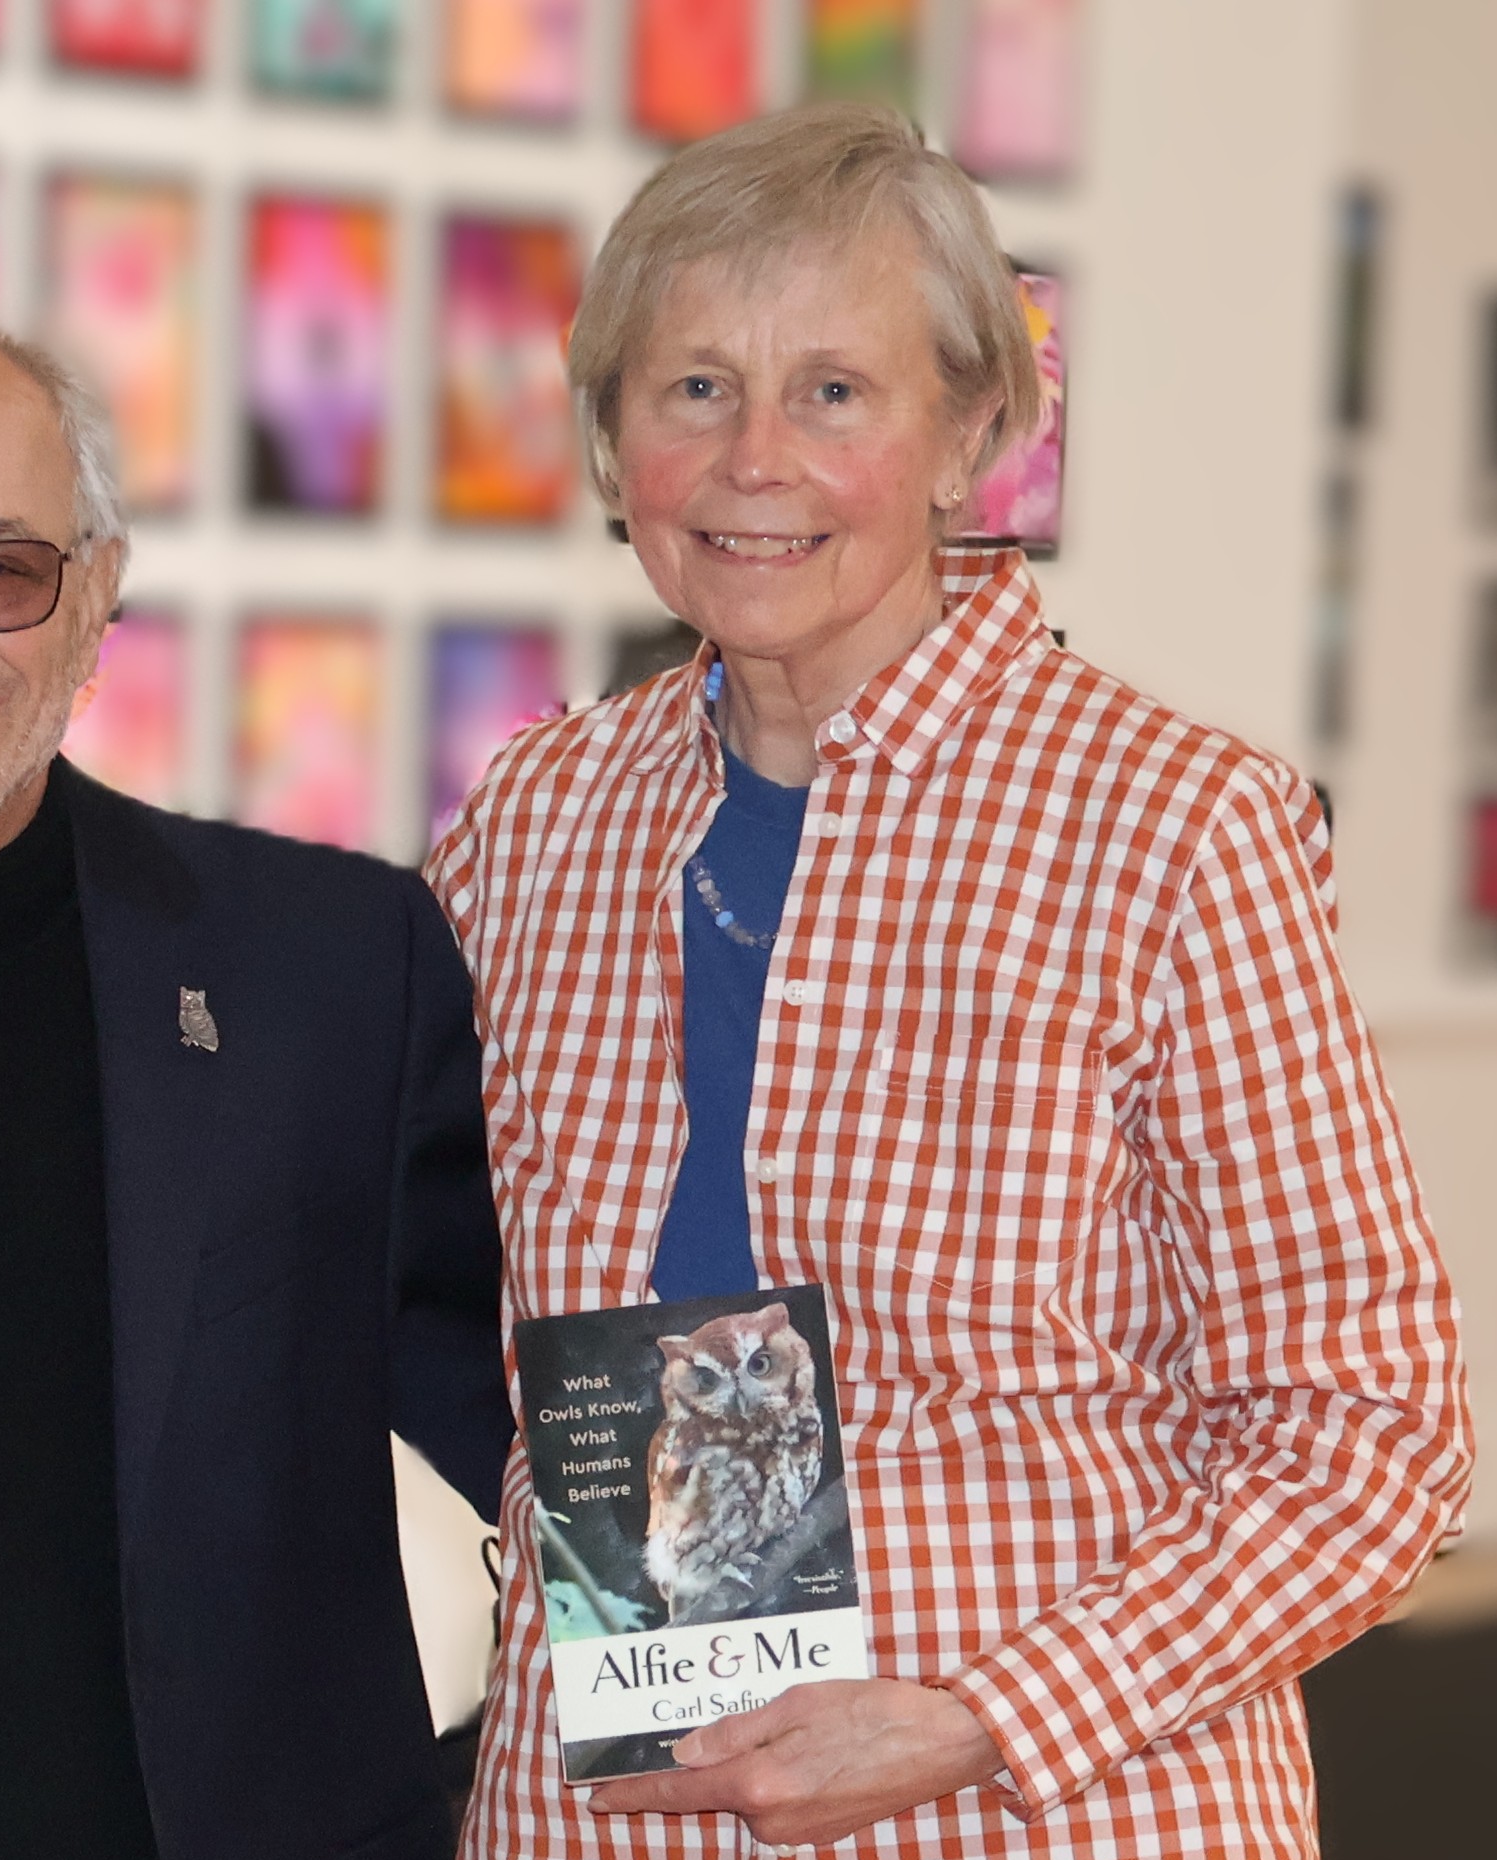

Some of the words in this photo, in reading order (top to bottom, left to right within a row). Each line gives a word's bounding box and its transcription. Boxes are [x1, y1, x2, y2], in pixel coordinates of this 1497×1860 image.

[562, 1374, 612, 1392] What
[539, 1405, 583, 1423] Owls
[587, 1400, 642, 1418] Know,
[569, 1429, 617, 1447] What
[562, 1457, 631, 1476] Humans
[568, 1484, 631, 1503] Believe
[591, 1643, 695, 1694] Alfie
[708, 1635, 745, 1678] &
[754, 1627, 831, 1674] Me
[652, 1696, 702, 1721] Carl
[710, 1690, 776, 1716] Safin
